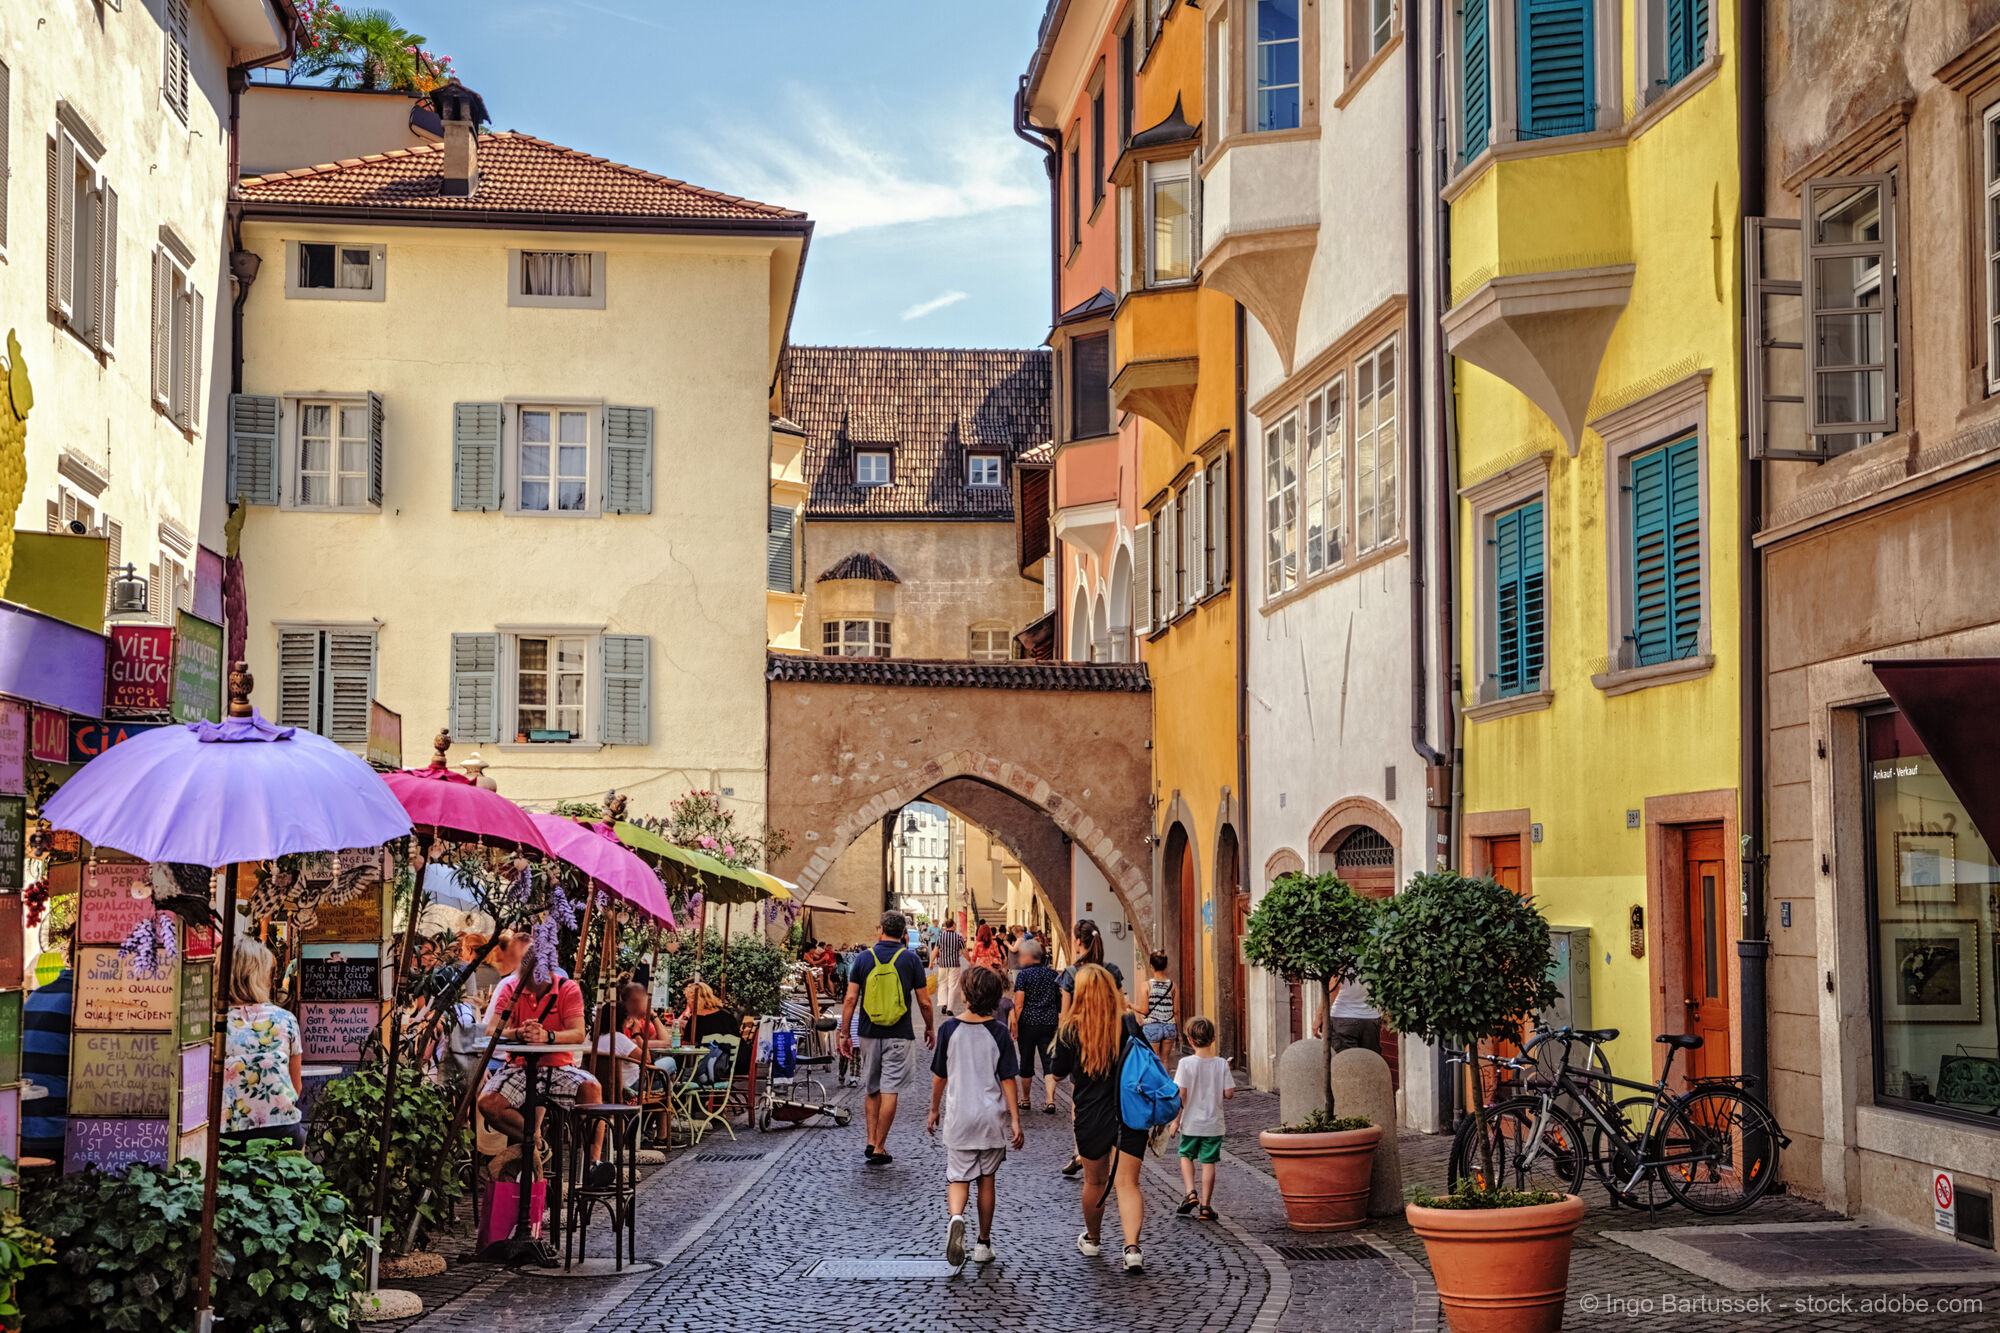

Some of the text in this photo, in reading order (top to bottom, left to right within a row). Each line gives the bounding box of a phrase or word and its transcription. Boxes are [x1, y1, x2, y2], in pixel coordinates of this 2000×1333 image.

[112, 659, 167, 683] GLÜCK
[118, 686, 155, 696] GOOD
[115, 696, 160, 707] LUCK
[1873, 768, 1892, 779] Ankauf
[1896, 765, 1918, 777] Verkauf
[85, 931, 121, 940] COLPO
[96, 954, 136, 968] Siao
[350, 1007, 368, 1015] ALLE
[304, 1026, 370, 1034] ABER MANCHE
[87, 1037, 121, 1050] GEH
[83, 1062, 127, 1077] AUCH
[80, 1138, 103, 1151] IST
[72, 1151, 101, 1161] ABER
[107, 1151, 138, 1160] MEHR
